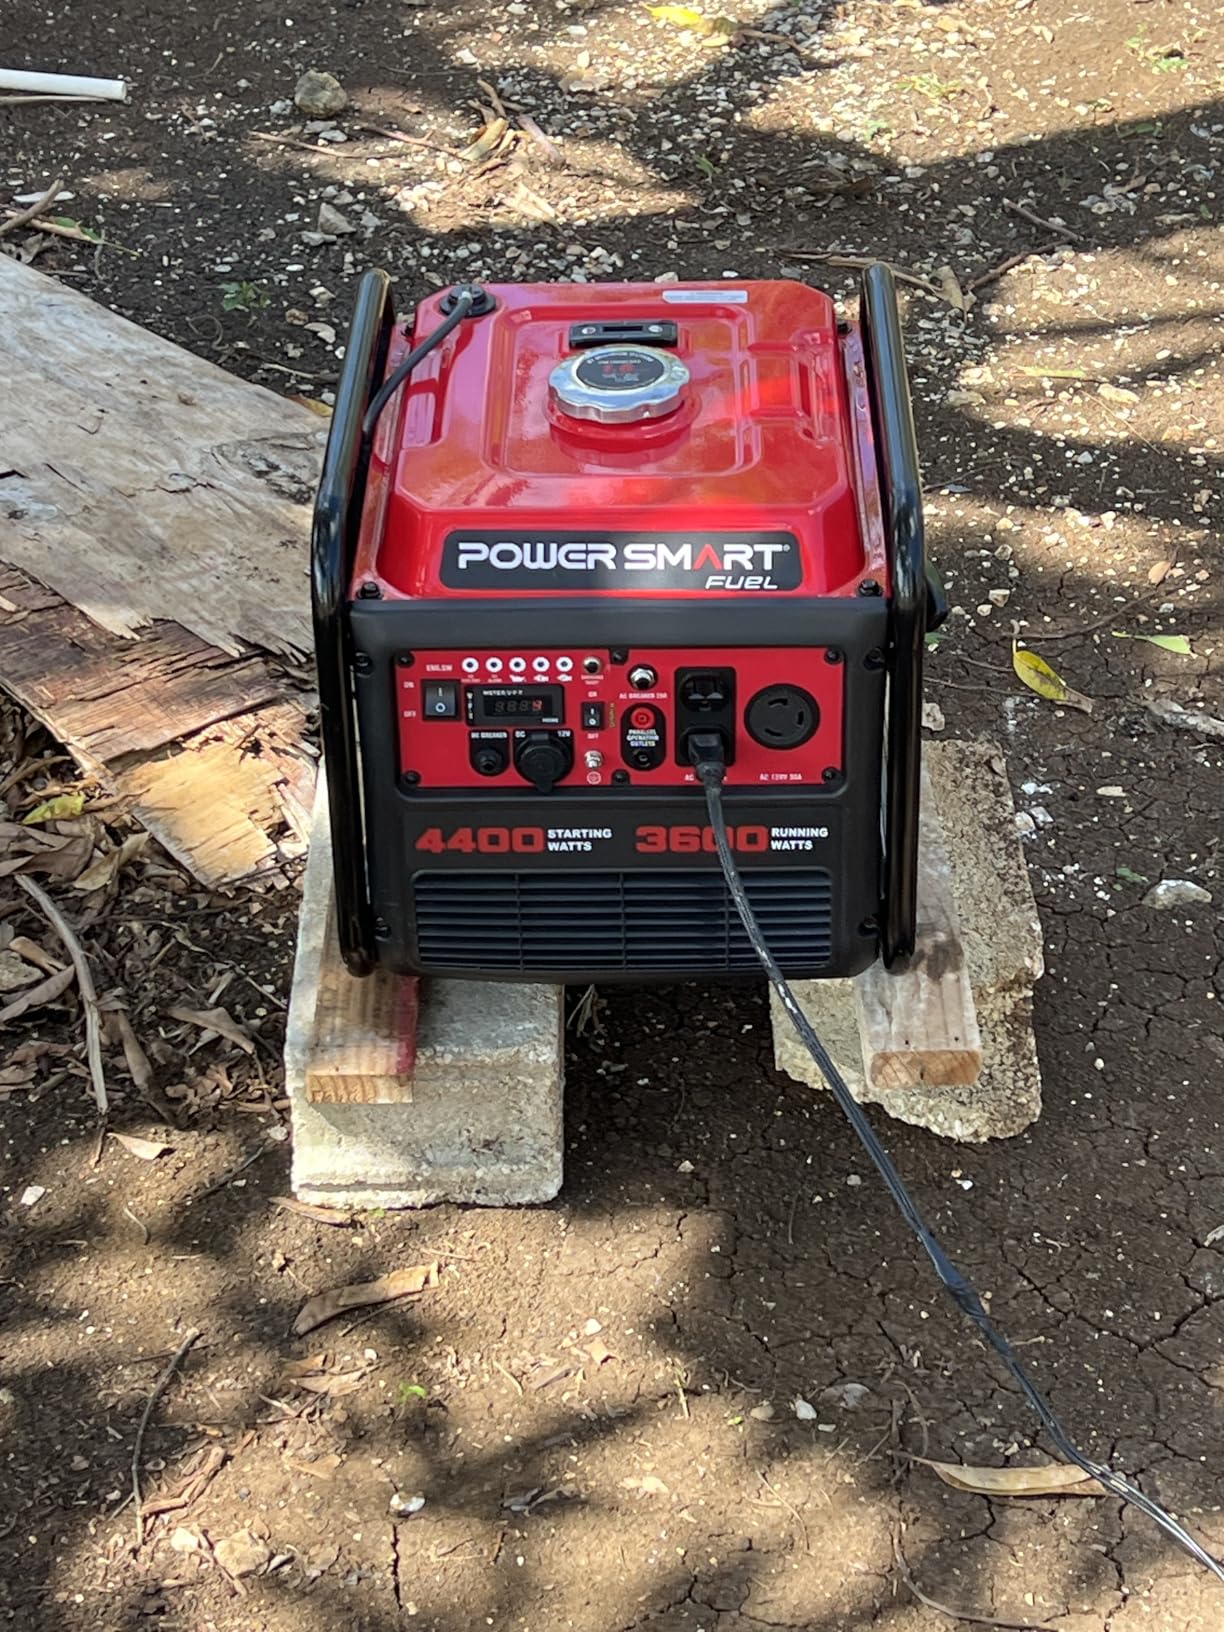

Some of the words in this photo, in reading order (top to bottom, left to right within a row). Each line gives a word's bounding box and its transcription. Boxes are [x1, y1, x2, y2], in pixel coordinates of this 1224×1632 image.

[704, 575, 778, 590] FUEL
[547, 827, 612, 840] STARTING
[770, 826, 829, 839] RUNNING
[415, 826, 545, 854] 4400
[547, 840, 592, 852] WATTS
[770, 839, 813, 851] WATTS
